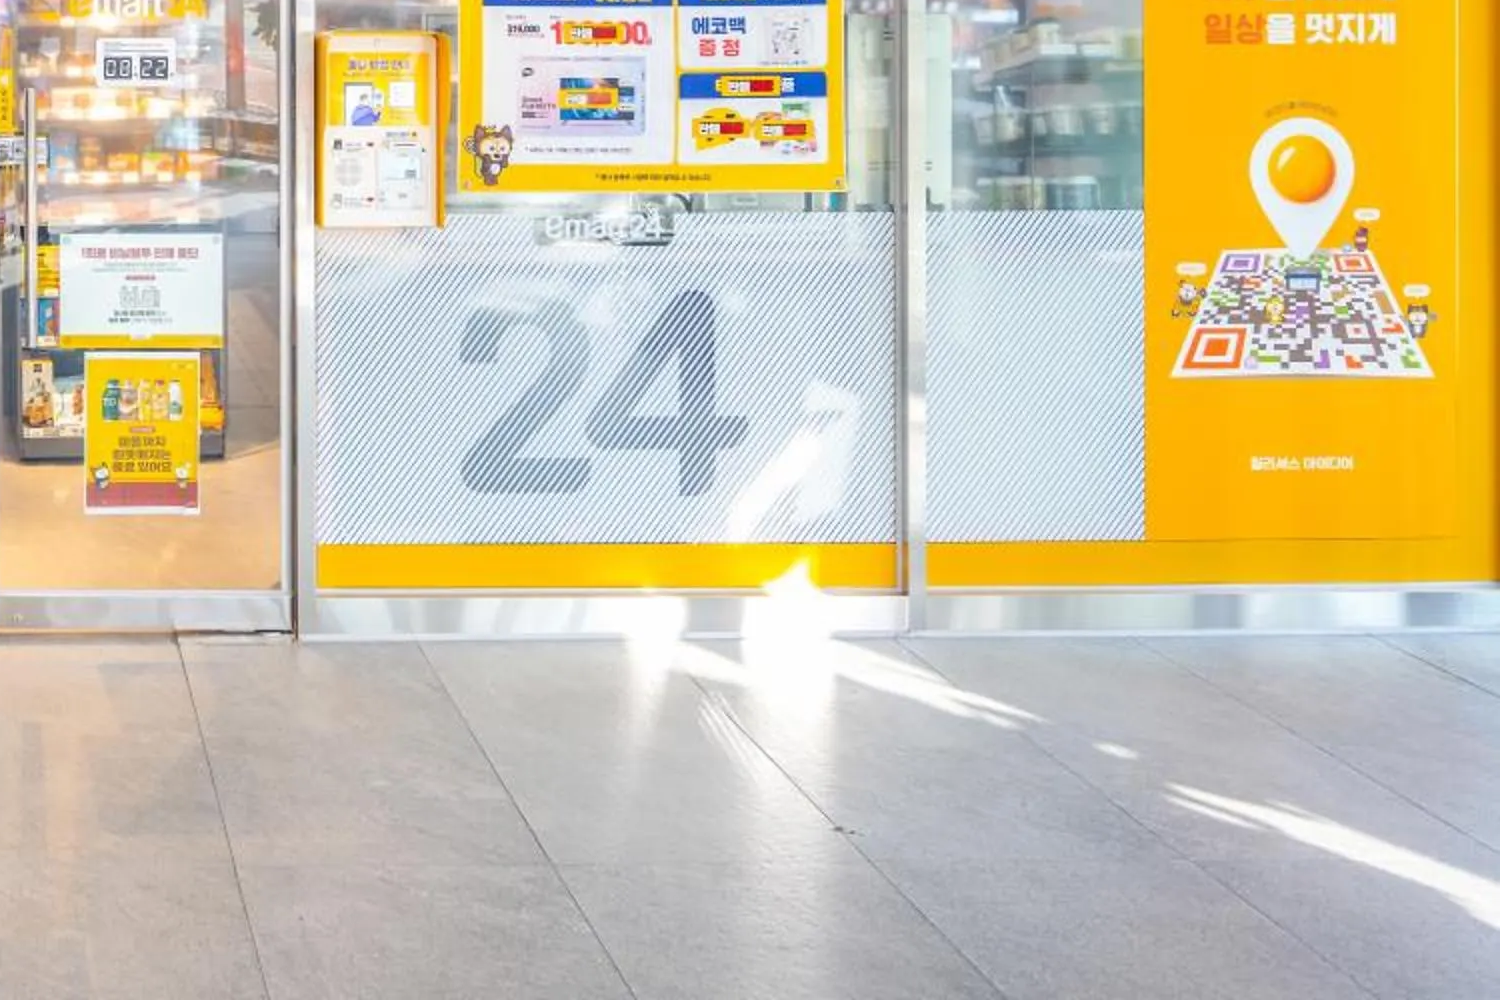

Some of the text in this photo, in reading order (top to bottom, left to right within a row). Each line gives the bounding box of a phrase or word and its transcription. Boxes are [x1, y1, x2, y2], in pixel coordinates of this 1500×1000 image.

[1204, 13, 1397, 44] 일상을 멋지게
[460, 288, 749, 496] 24
[1250, 456, 1354, 471] 딜리셔스 아이디어
